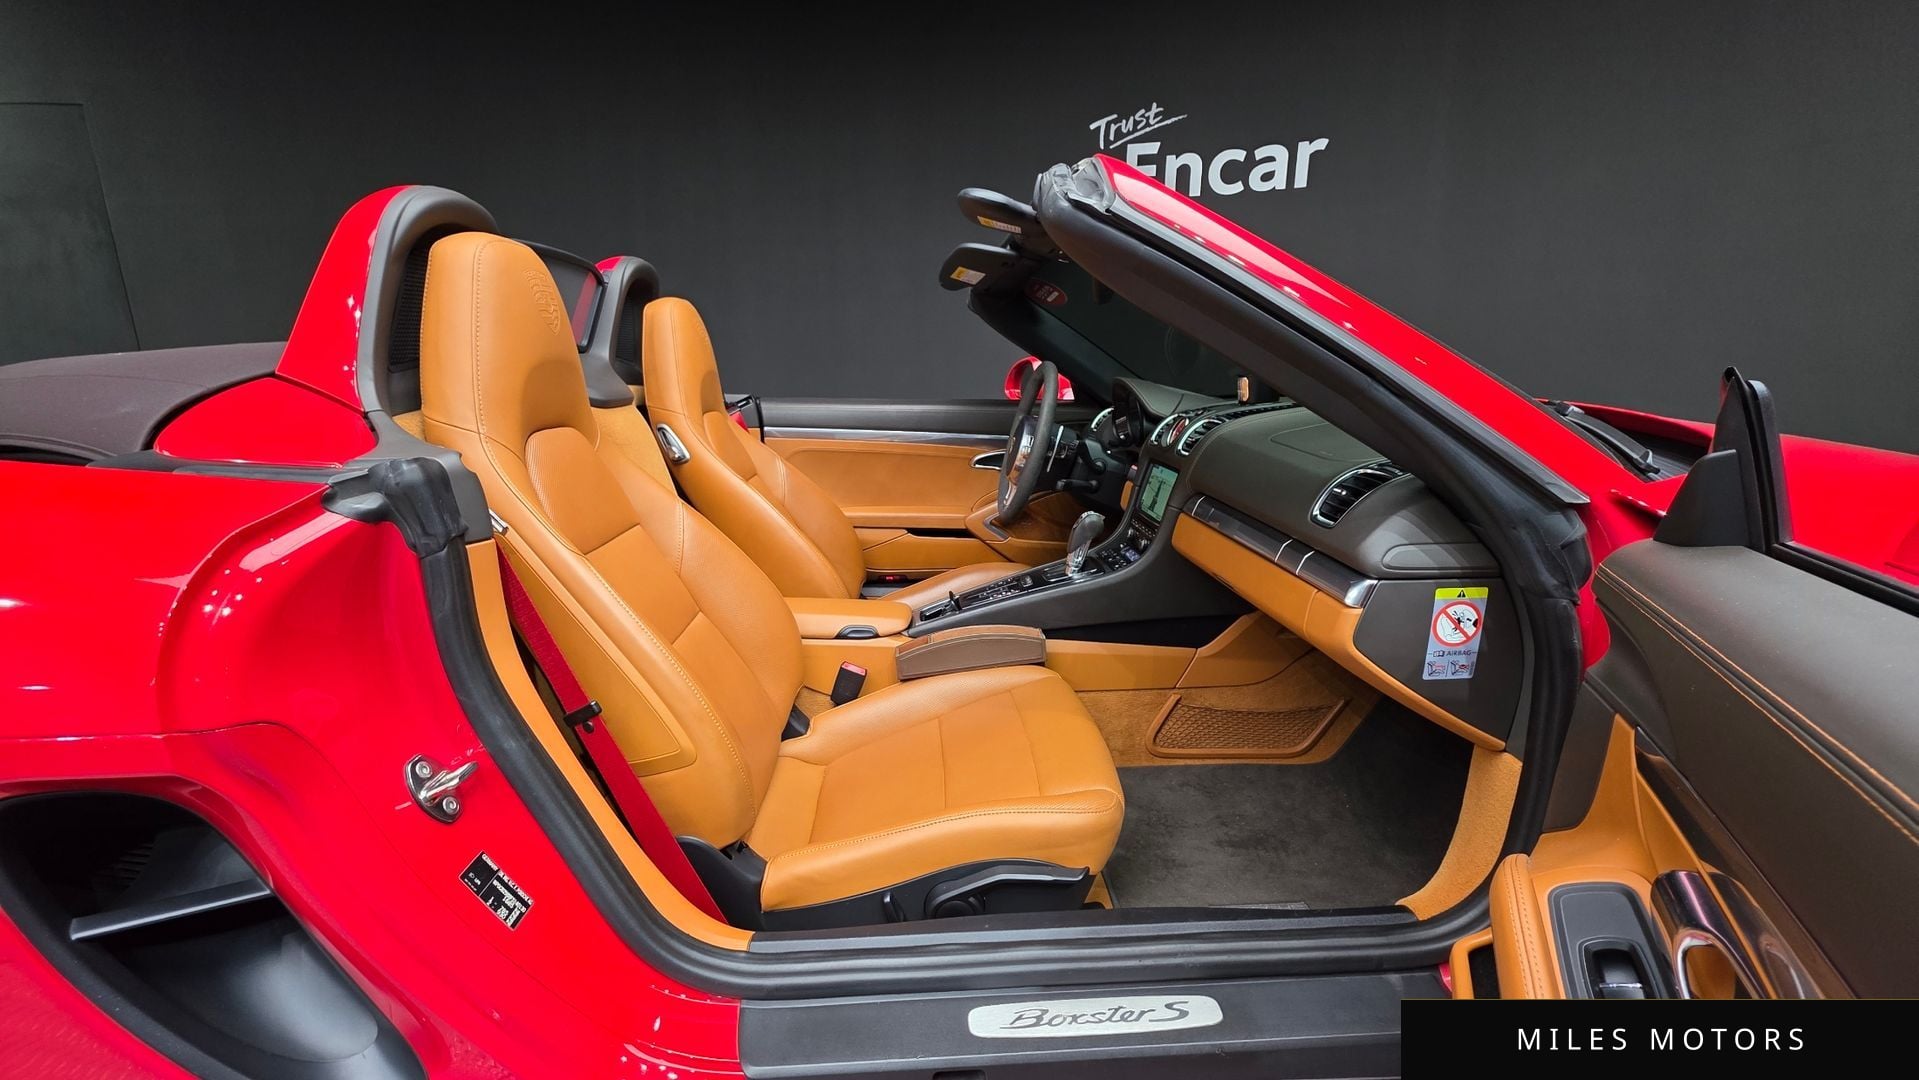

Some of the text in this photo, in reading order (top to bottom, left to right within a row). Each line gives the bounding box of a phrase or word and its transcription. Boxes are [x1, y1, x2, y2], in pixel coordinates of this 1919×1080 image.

[1090, 102, 1170, 149] Trust
[1000, 1001, 1189, 1029] Boxster S
